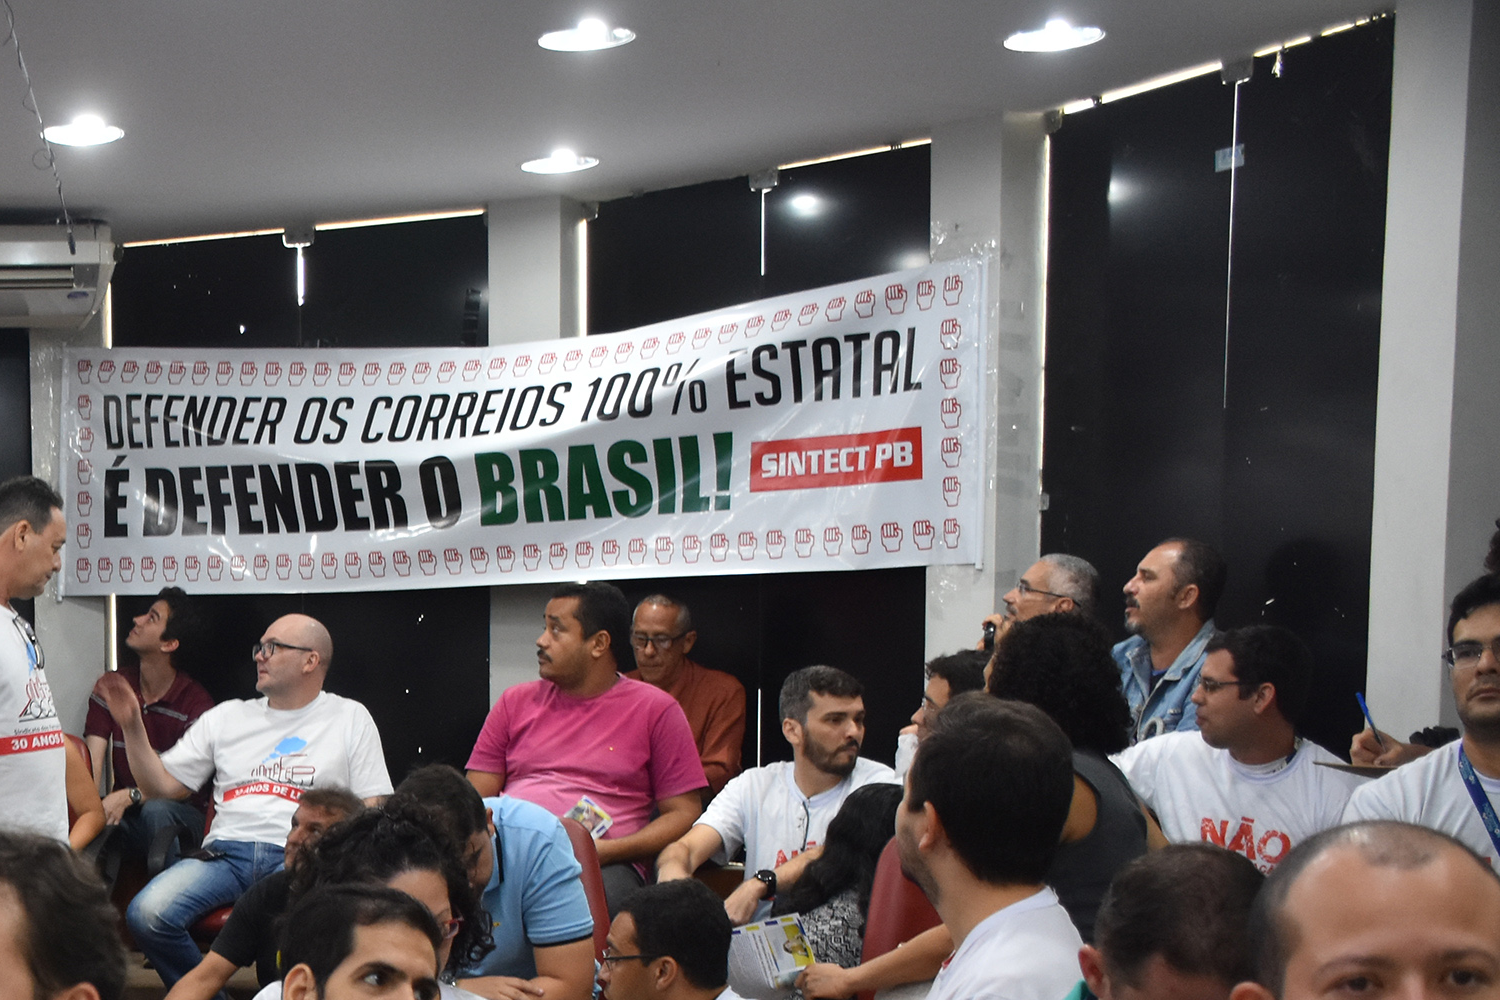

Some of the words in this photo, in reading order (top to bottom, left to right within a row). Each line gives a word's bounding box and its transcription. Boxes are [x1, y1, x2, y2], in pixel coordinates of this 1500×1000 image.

[103, 393, 287, 450] DEFENDER
[292, 396, 354, 445] OS
[360, 380, 573, 443] CORREIOS
[581, 358, 708, 422] 100%
[725, 326, 922, 411] ESTATAL
[760, 444, 872, 479] SINTECT
[874, 440, 914, 469] PB
[104, 454, 130, 538] É
[142, 459, 409, 537] DEFENDER
[419, 455, 463, 530] O
[474, 431, 734, 527] BRASIL!
[11, 738, 28, 750] 30
[272, 785, 288, 796] DE
[1201, 816, 1291, 864] NÃO
